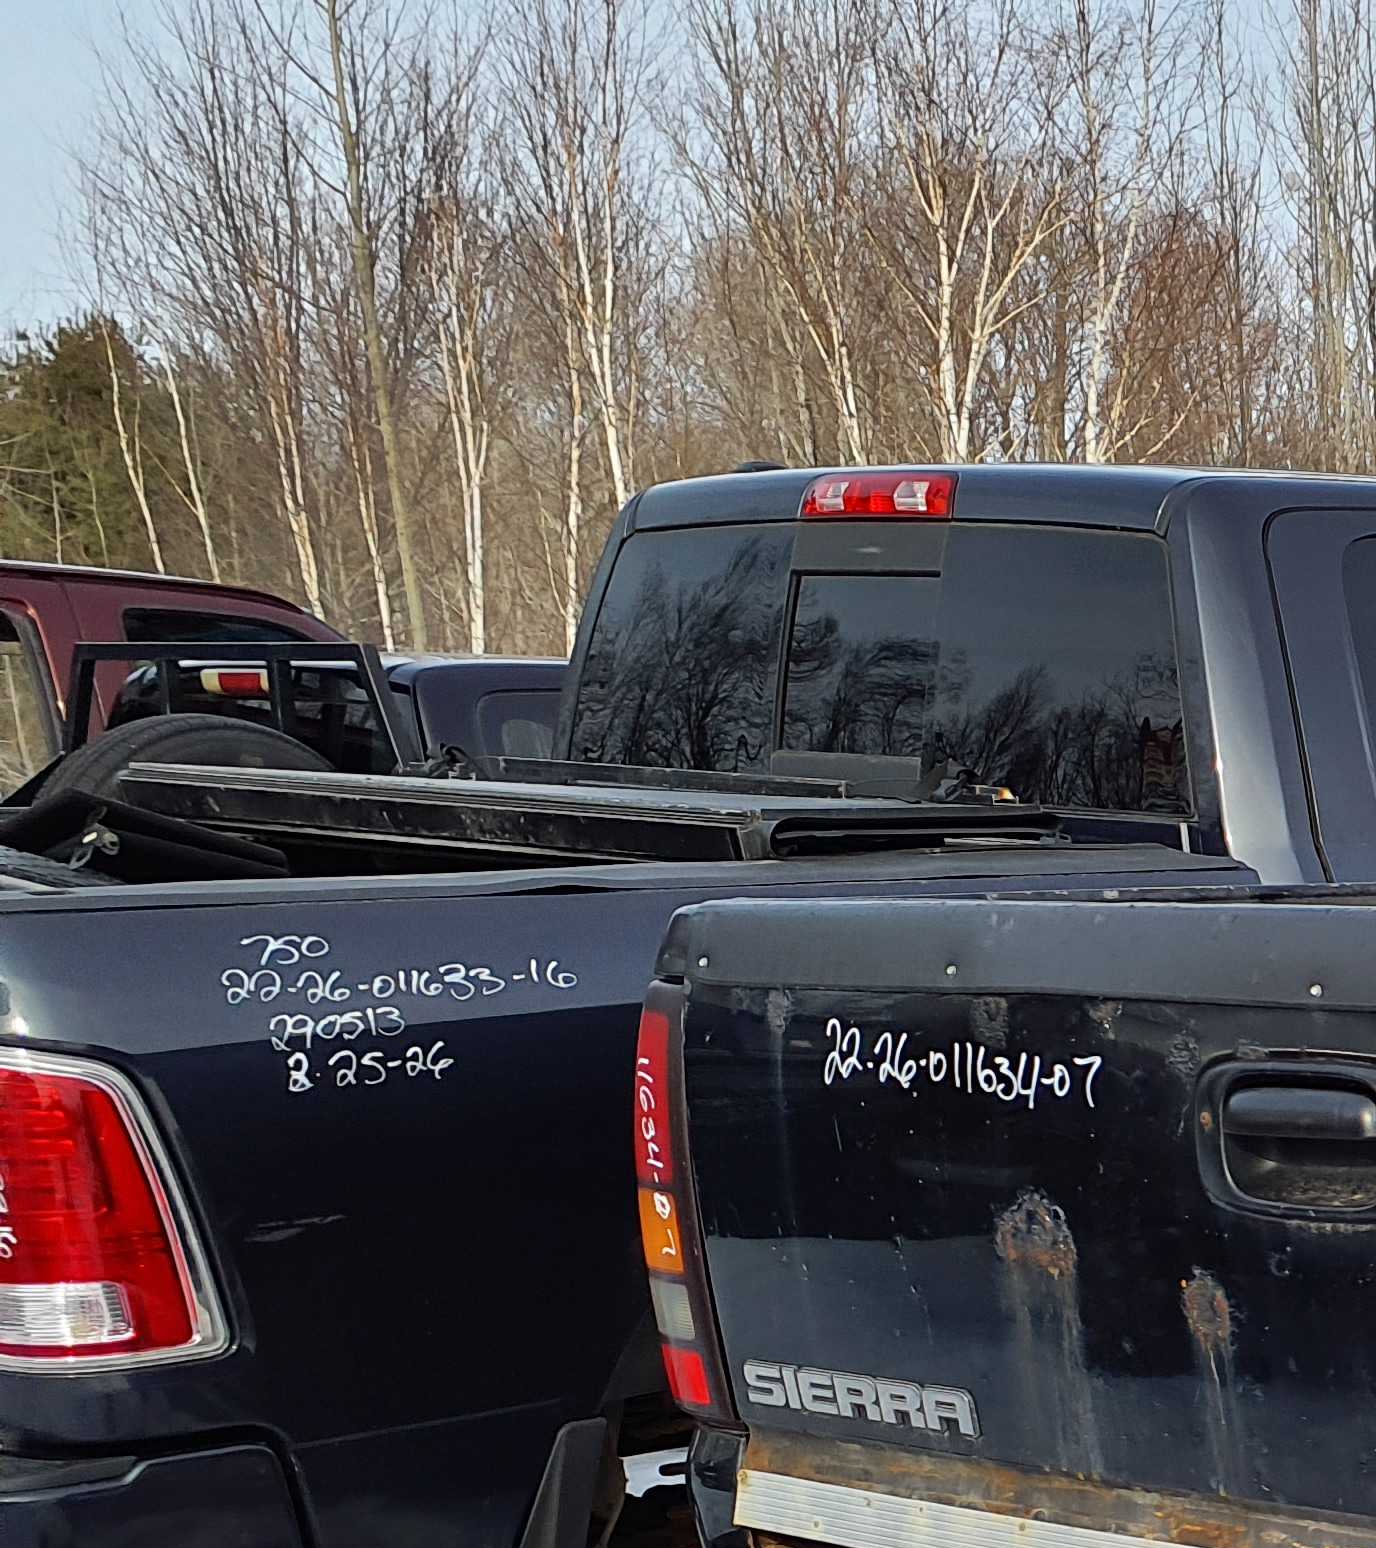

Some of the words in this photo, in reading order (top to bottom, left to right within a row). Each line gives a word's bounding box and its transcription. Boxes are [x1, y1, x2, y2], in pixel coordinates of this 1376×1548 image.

[241, 935, 328, 966] 750
[269, 1006, 405, 1050] 290513
[743, 1359, 983, 1440] SIERRA
